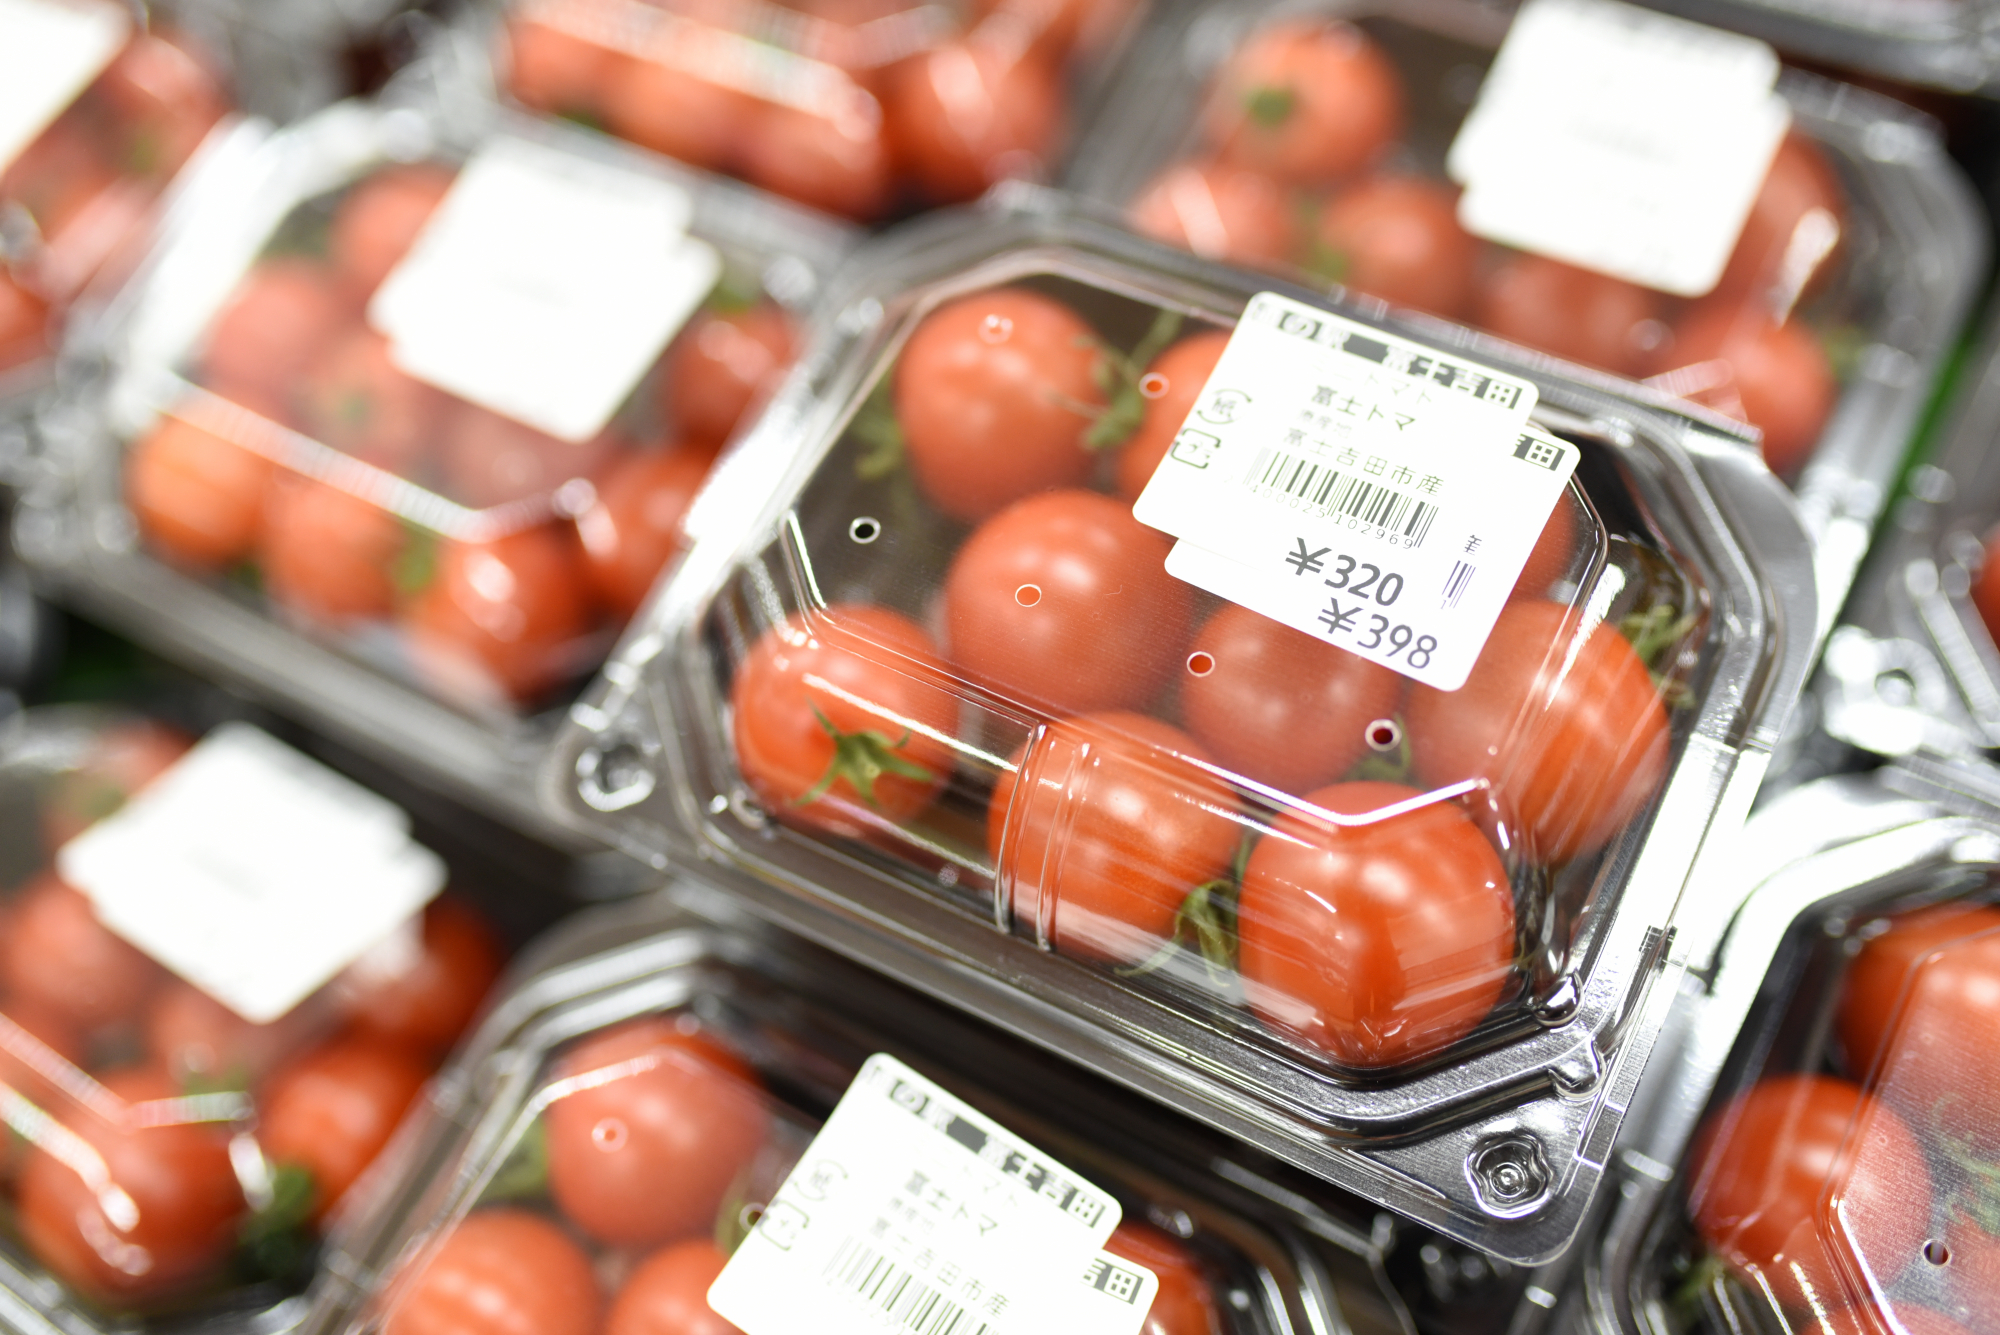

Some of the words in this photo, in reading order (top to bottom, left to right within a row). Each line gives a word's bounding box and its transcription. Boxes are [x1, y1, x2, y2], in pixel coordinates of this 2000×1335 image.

[1310, 384, 1416, 431] 富士トマ
[1283, 427, 1444, 496] 富士吉田市産
[1285, 536, 1404, 607] ¥320
[1317, 596, 1438, 669] ¥398
